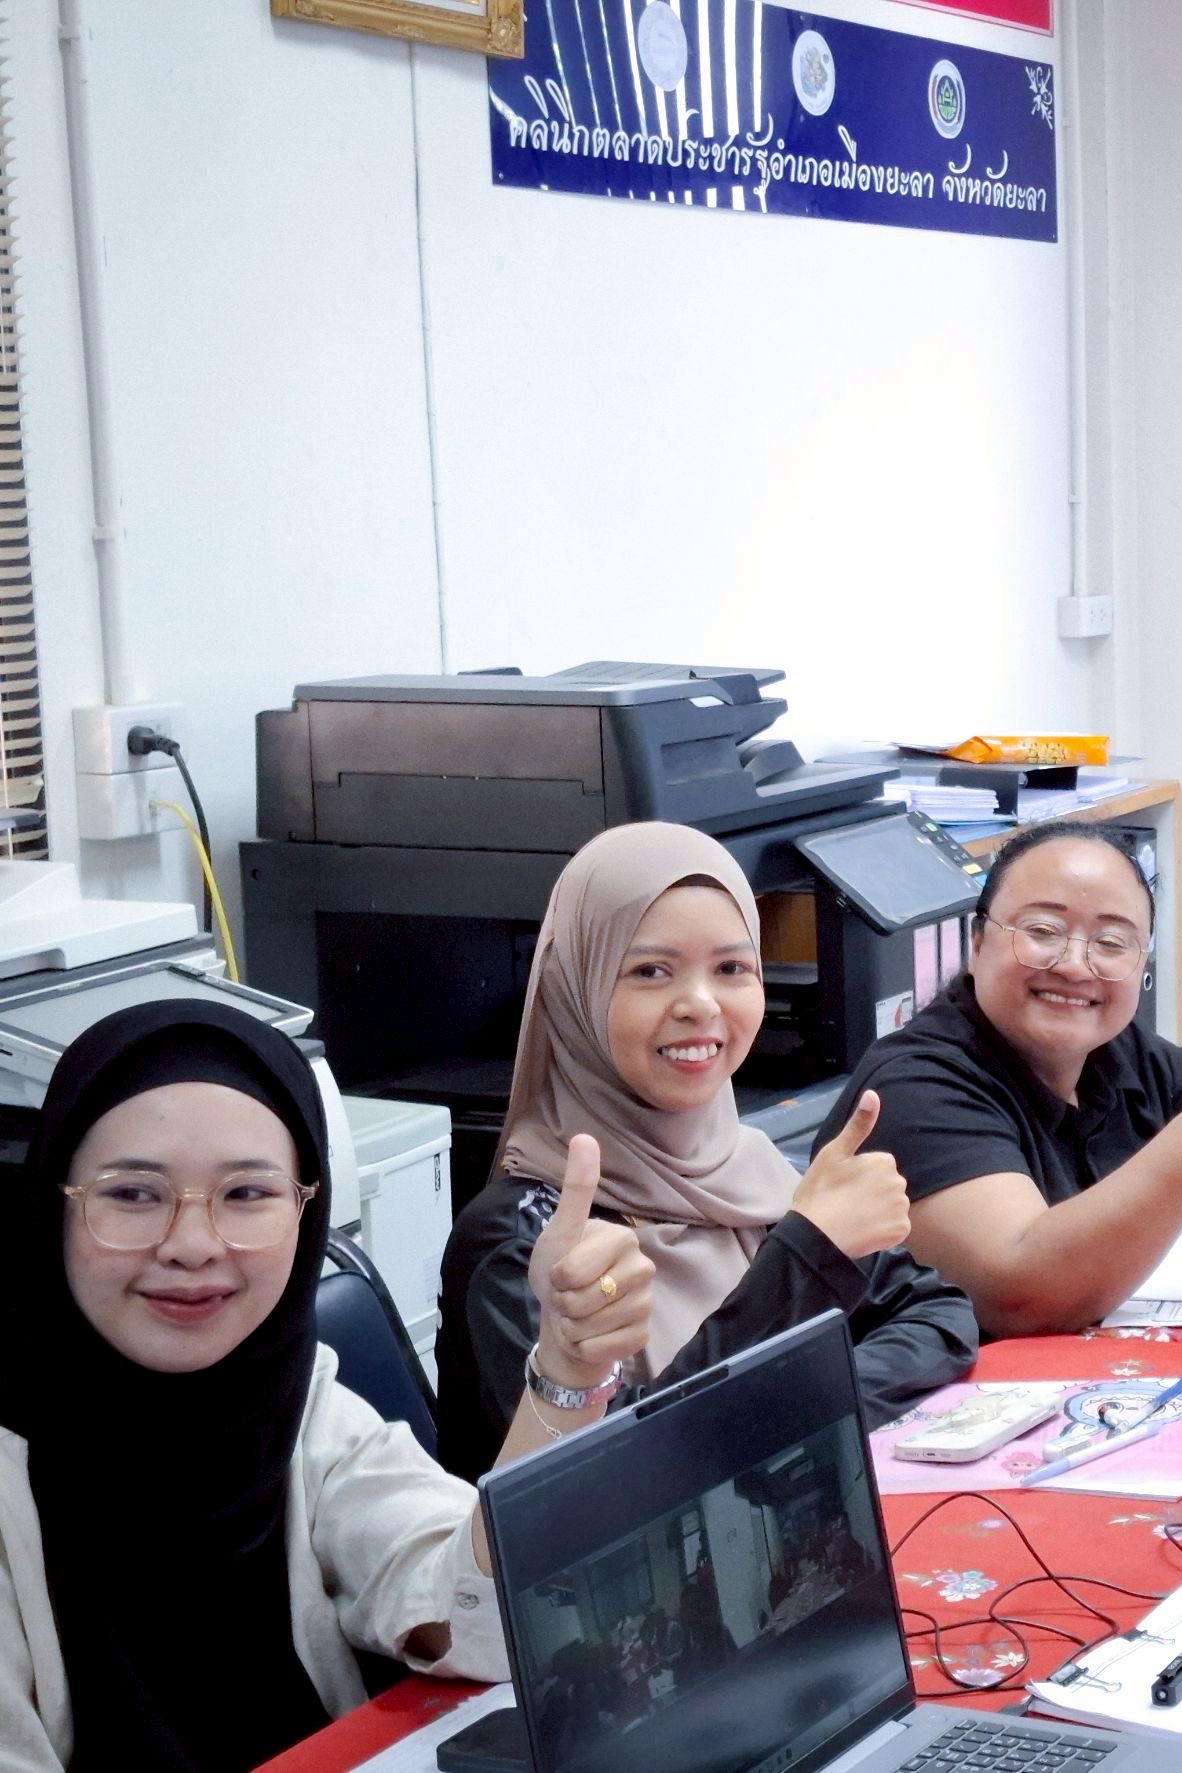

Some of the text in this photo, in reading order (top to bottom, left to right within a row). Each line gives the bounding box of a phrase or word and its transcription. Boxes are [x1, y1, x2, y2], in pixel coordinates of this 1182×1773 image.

[942, 143, 1047, 212] จังหวัดยะลา
